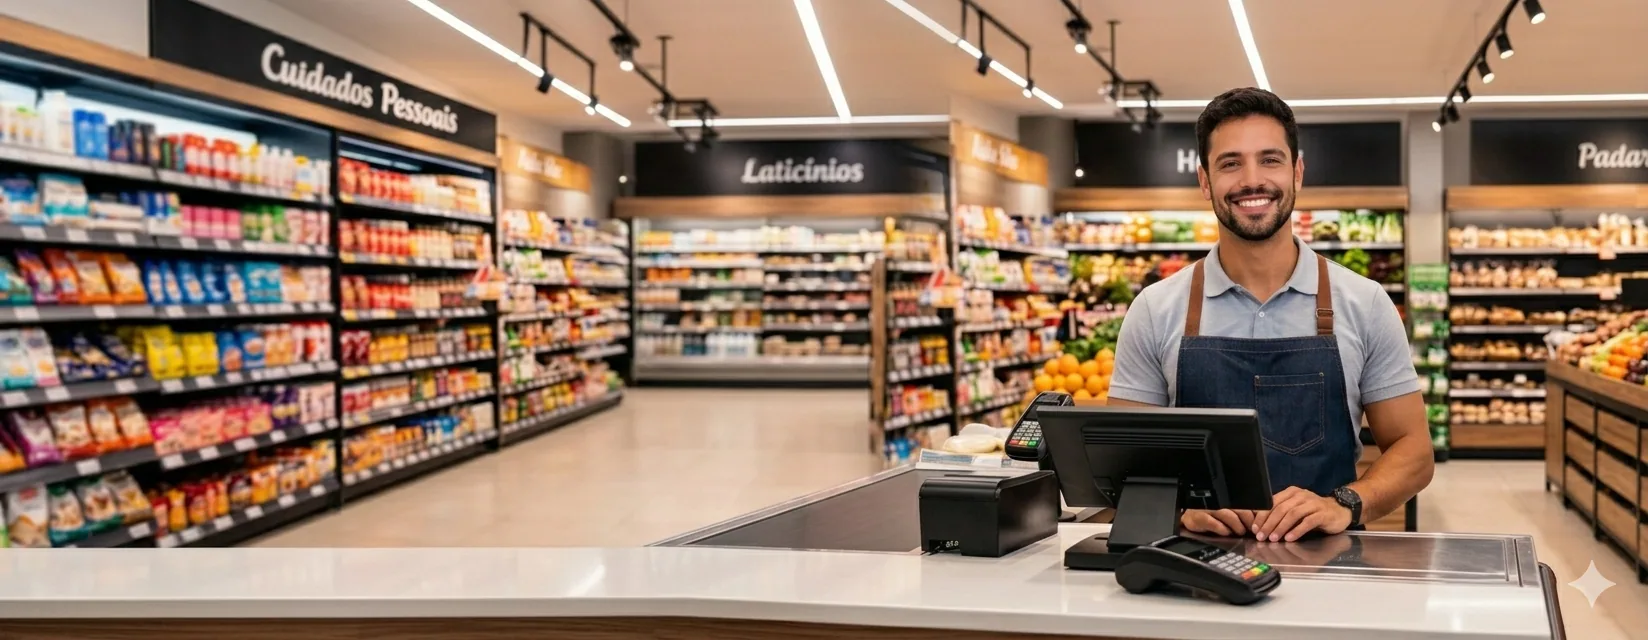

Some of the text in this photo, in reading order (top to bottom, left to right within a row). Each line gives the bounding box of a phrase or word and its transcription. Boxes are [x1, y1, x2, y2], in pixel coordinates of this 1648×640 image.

[261, 42, 459, 134] Cuidados Pessoais
[740, 156, 865, 184] Laticínios
